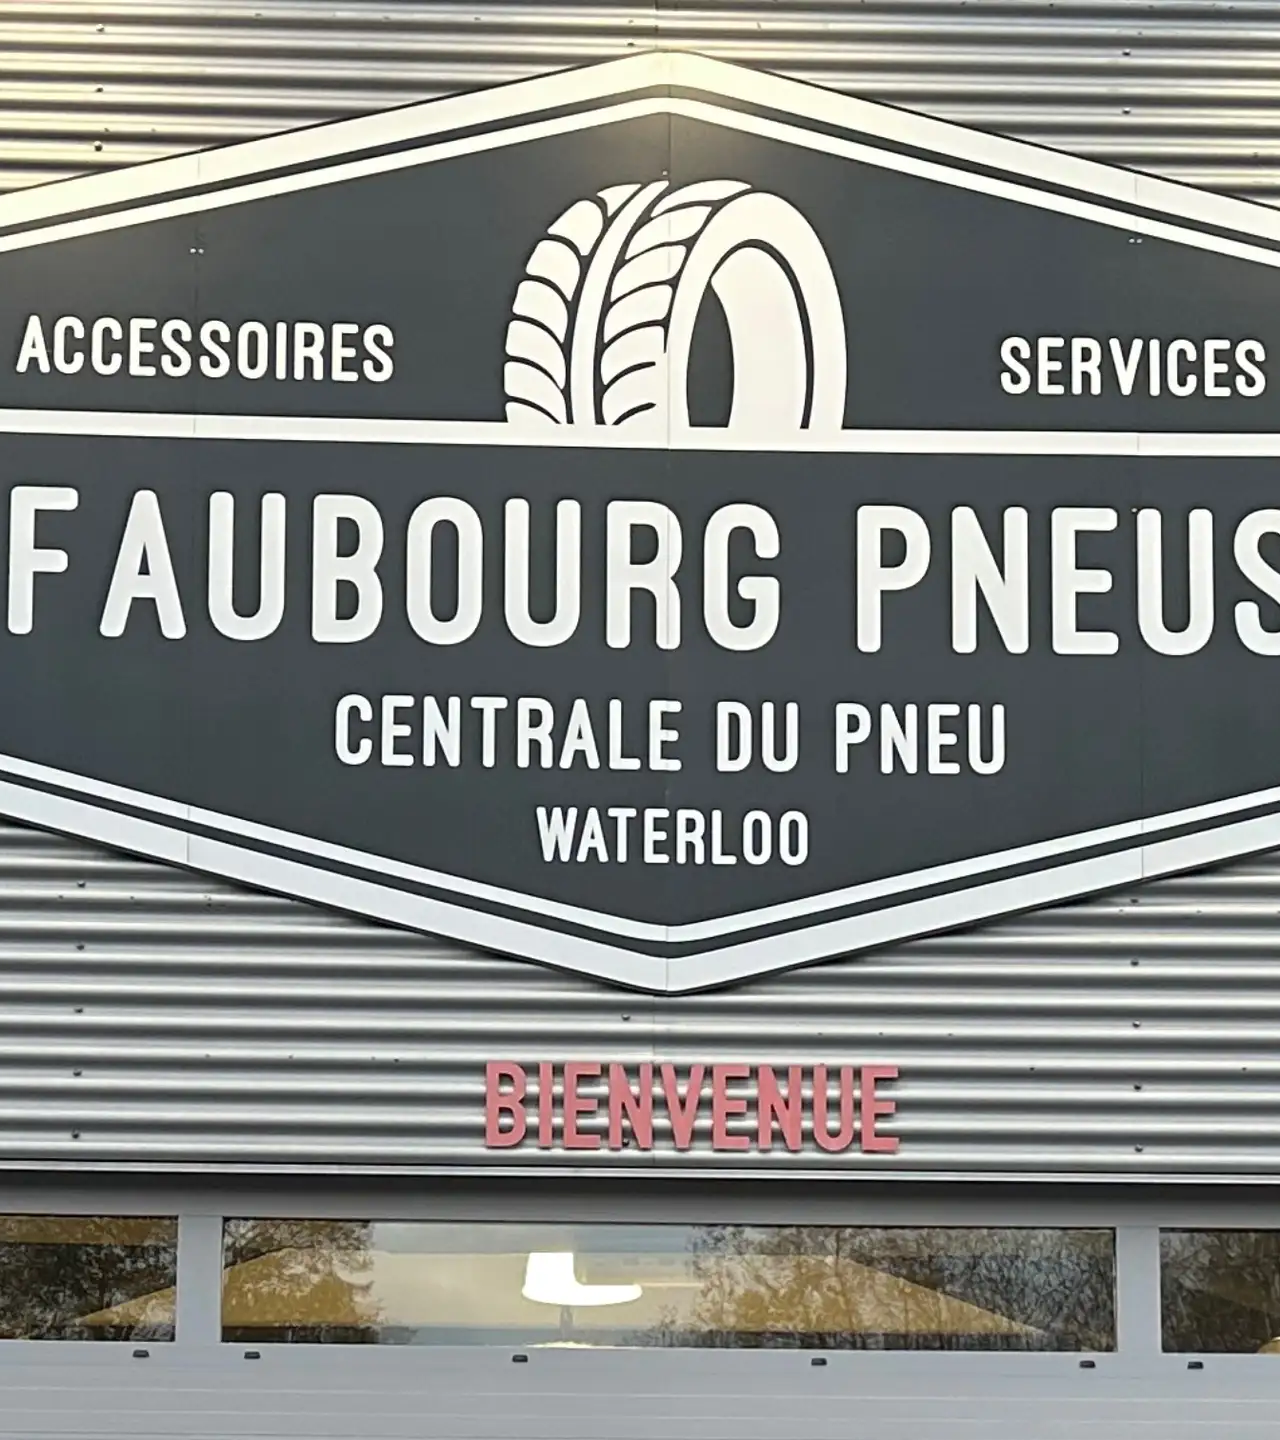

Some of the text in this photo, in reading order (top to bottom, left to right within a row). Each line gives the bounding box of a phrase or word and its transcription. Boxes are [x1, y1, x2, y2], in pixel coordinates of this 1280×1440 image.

[15, 315, 395, 383] ACCESSOIRES
[1000, 336, 1267, 397] SERVICES
[7, 486, 781, 651] FAUBOURG
[335, 694, 1007, 775] CENTRALE DU PNEU
[536, 806, 810, 866] WATERLOO
[486, 1061, 900, 1153] BIENVENUE
